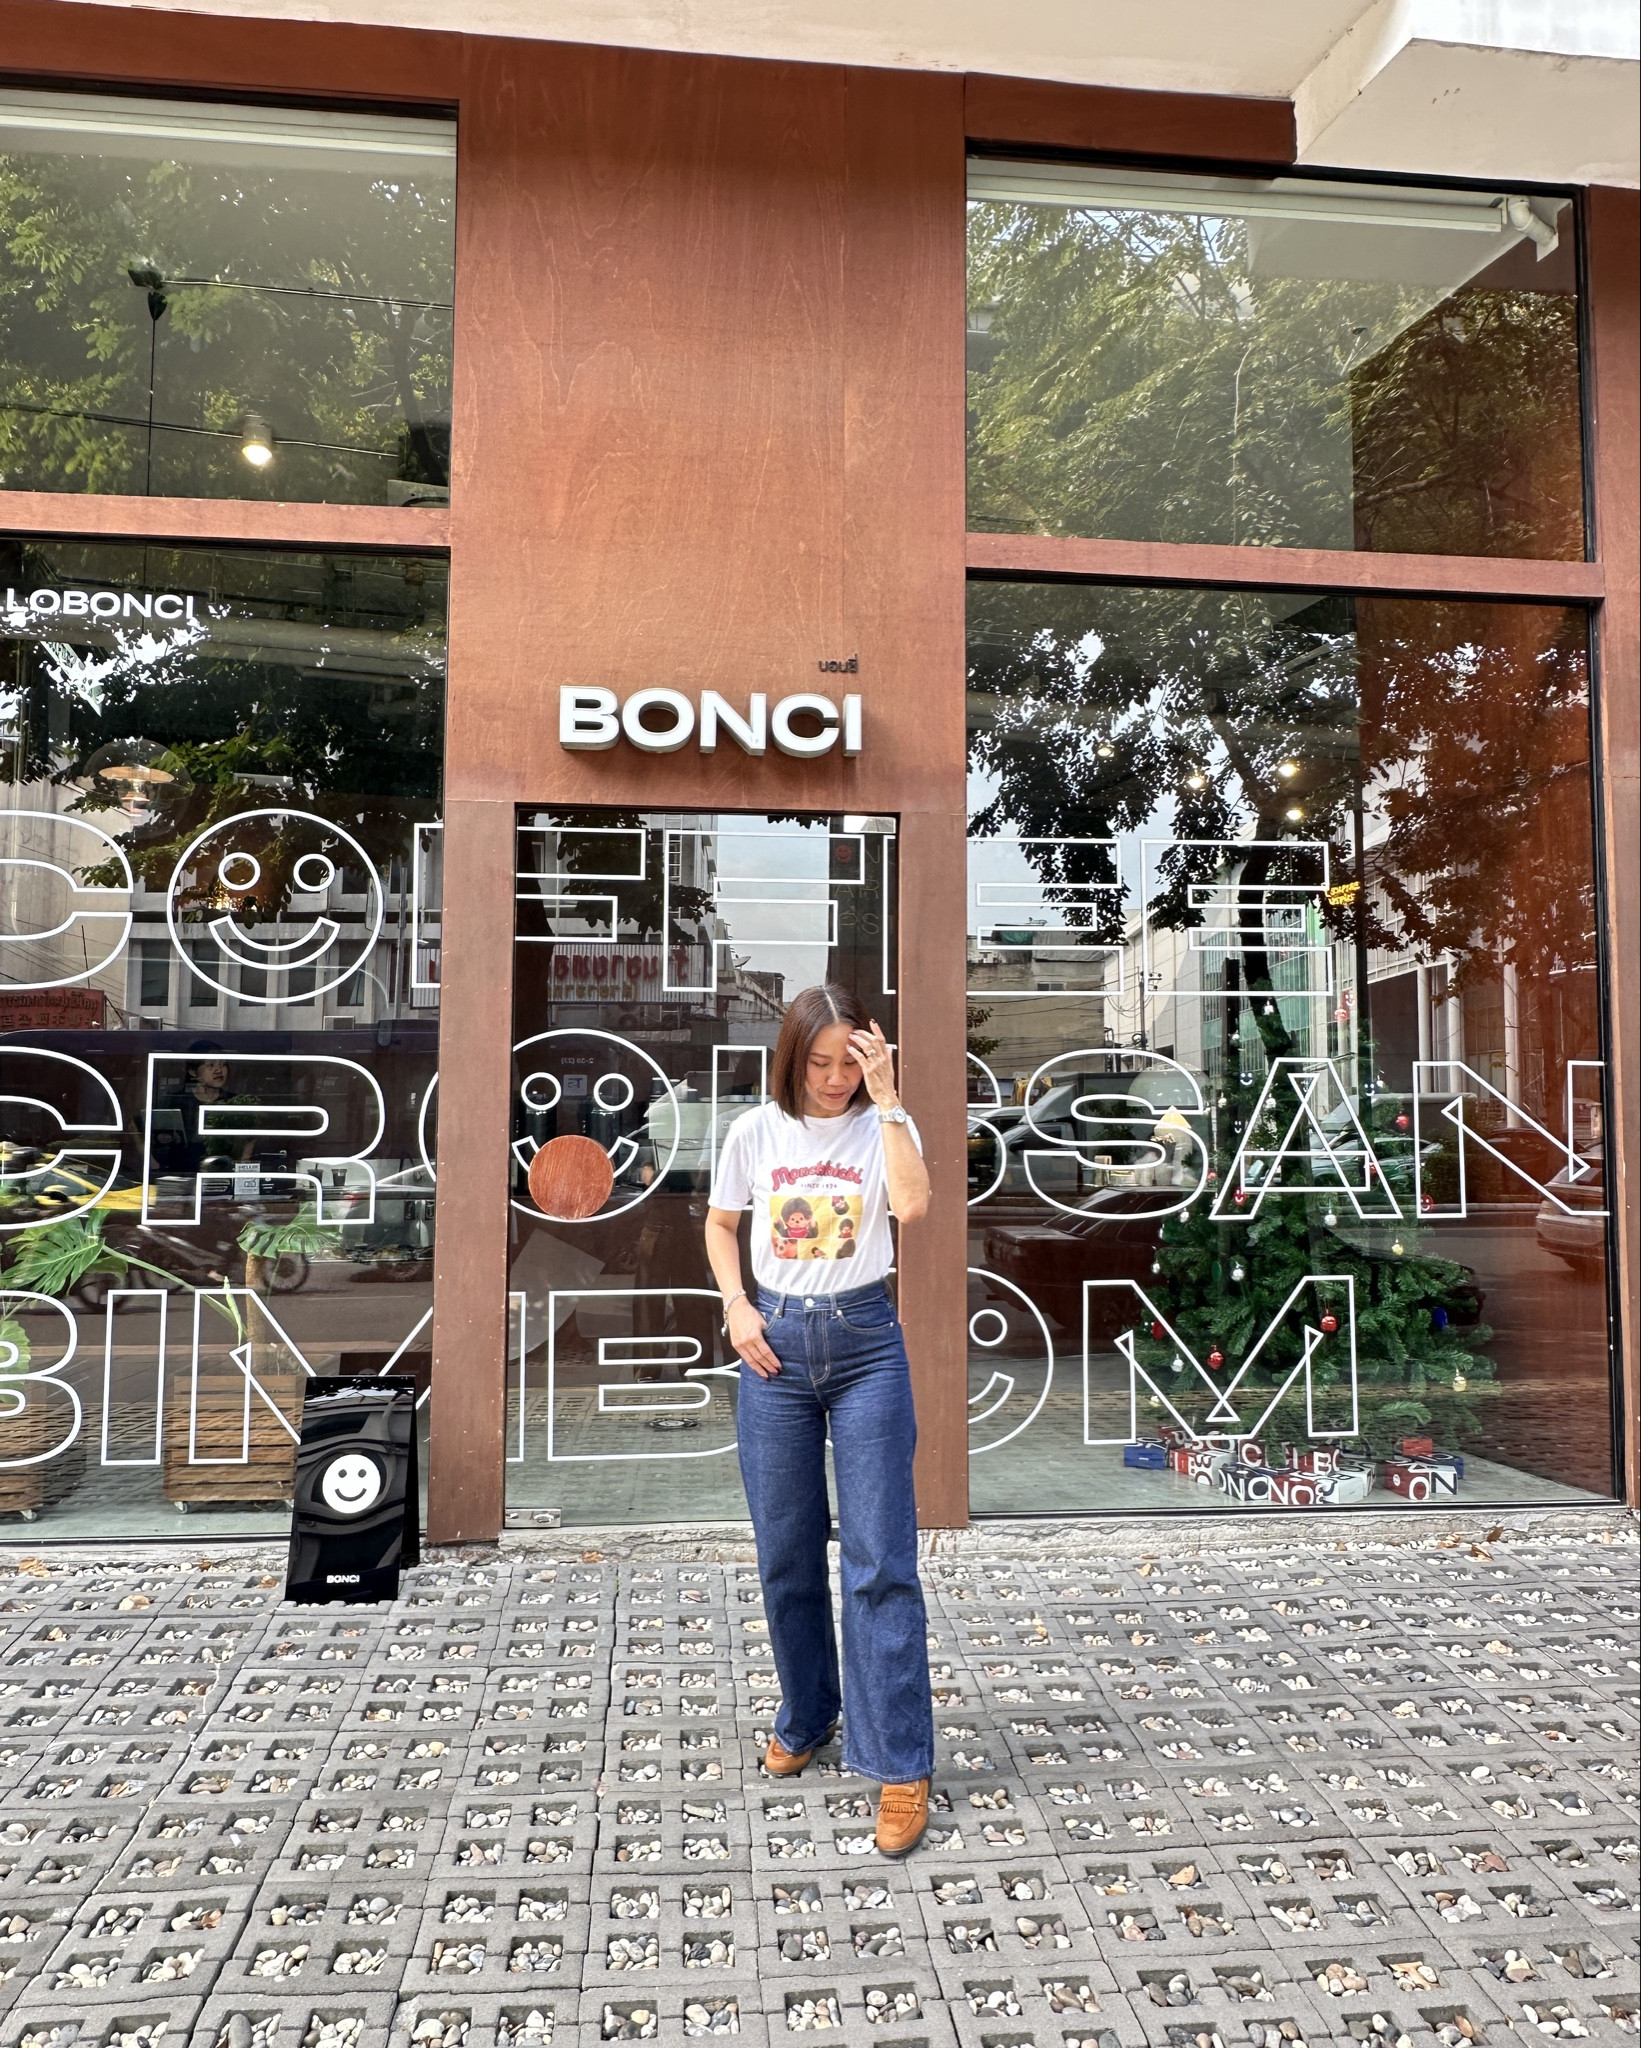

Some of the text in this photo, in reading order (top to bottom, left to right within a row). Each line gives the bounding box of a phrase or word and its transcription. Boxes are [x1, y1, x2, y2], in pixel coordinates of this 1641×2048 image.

[0, 588, 194, 619] LOBONCI
[560, 685, 862, 758] BONCI
[326, 1574, 361, 1584] BONCI
